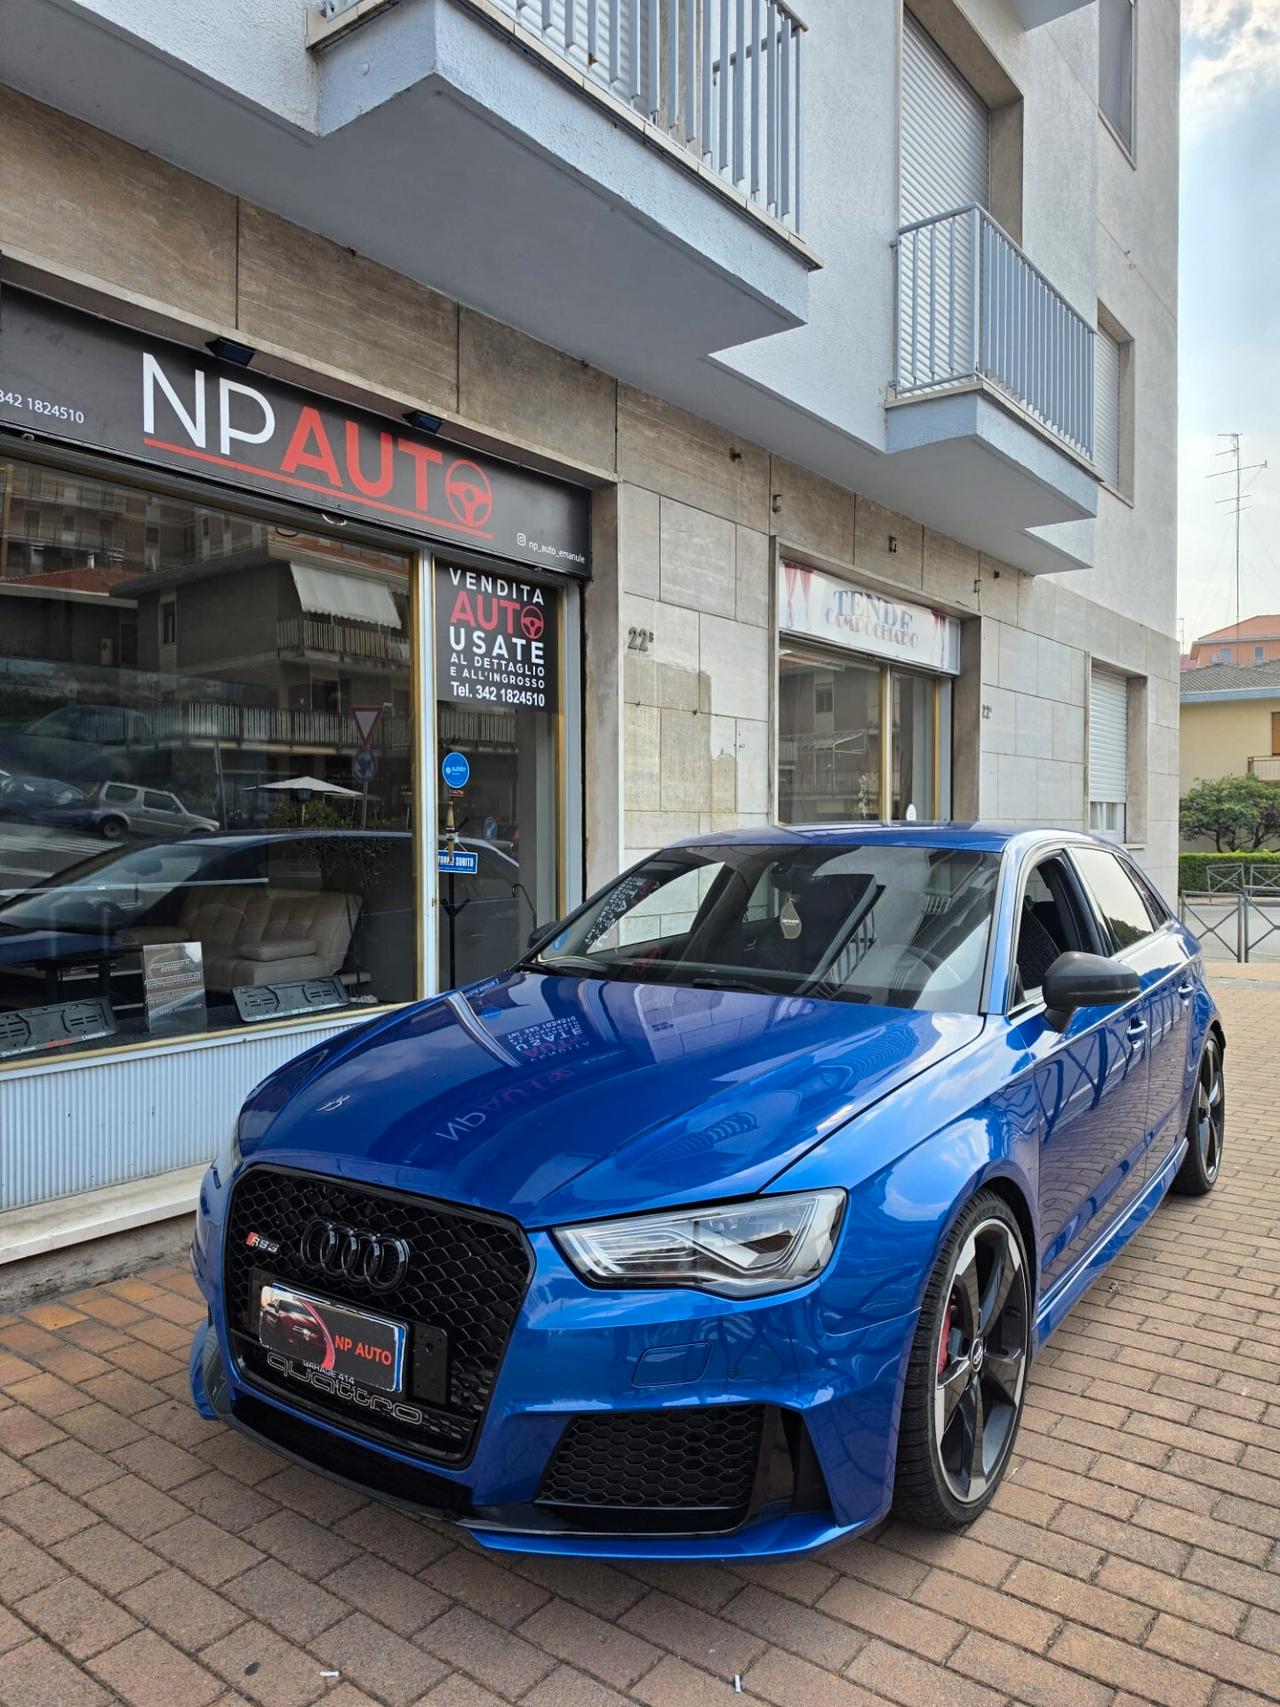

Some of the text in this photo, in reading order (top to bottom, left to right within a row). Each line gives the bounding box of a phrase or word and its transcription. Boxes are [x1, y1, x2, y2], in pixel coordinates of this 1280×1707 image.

[27, 397, 84, 424] 1824510
[449, 567, 545, 606] VENDITA
[450, 590, 545, 640] AUTO
[449, 626, 545, 665] USATE
[450, 652, 545, 677] AL DETTAGLIO
[450, 666, 545, 689] E ALL'INGROSSO
[450, 681, 545, 707] Tel. 342 1824510
[334, 1334, 393, 1366] NP AUTO
[267, 1351, 423, 1425] quattro
